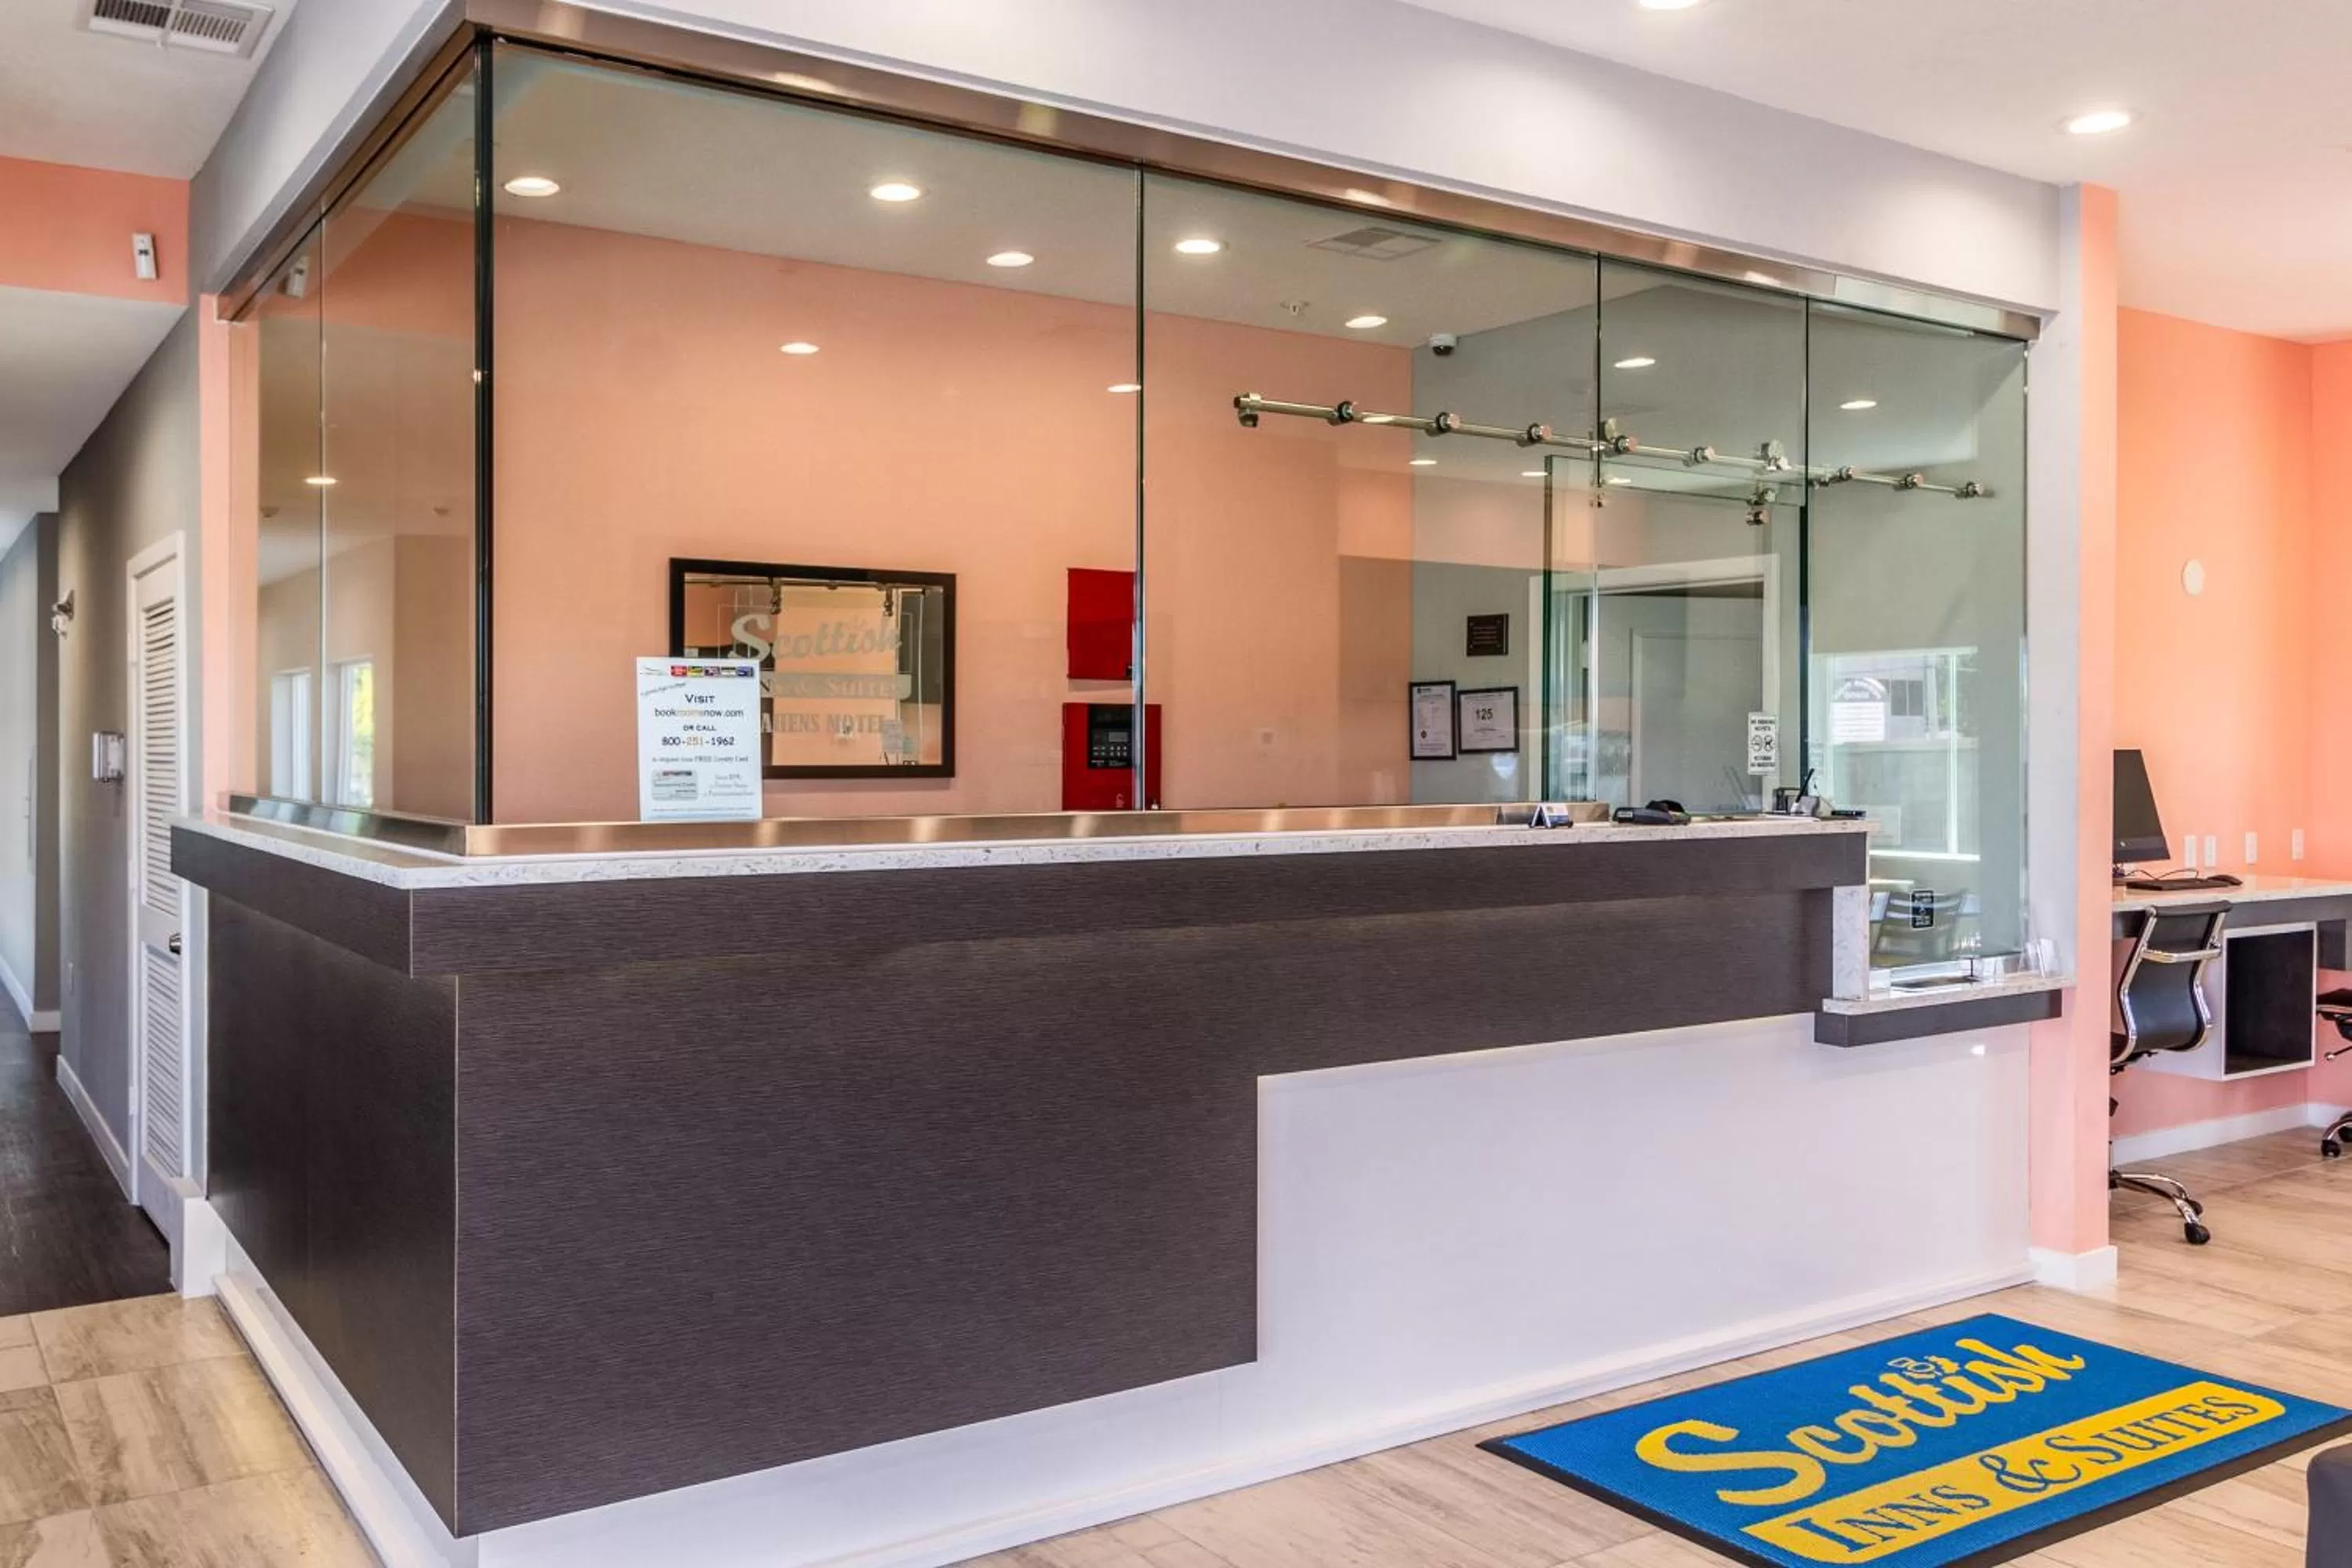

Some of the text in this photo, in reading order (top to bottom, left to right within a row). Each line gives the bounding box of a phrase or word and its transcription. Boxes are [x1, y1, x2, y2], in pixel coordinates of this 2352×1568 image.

[728, 615, 902, 662] Scottish
[1475, 708, 1494, 720] 125
[1635, 1338, 2085, 1505] Scottish
[1786, 1394, 2259, 1554] INNS & SUITES
